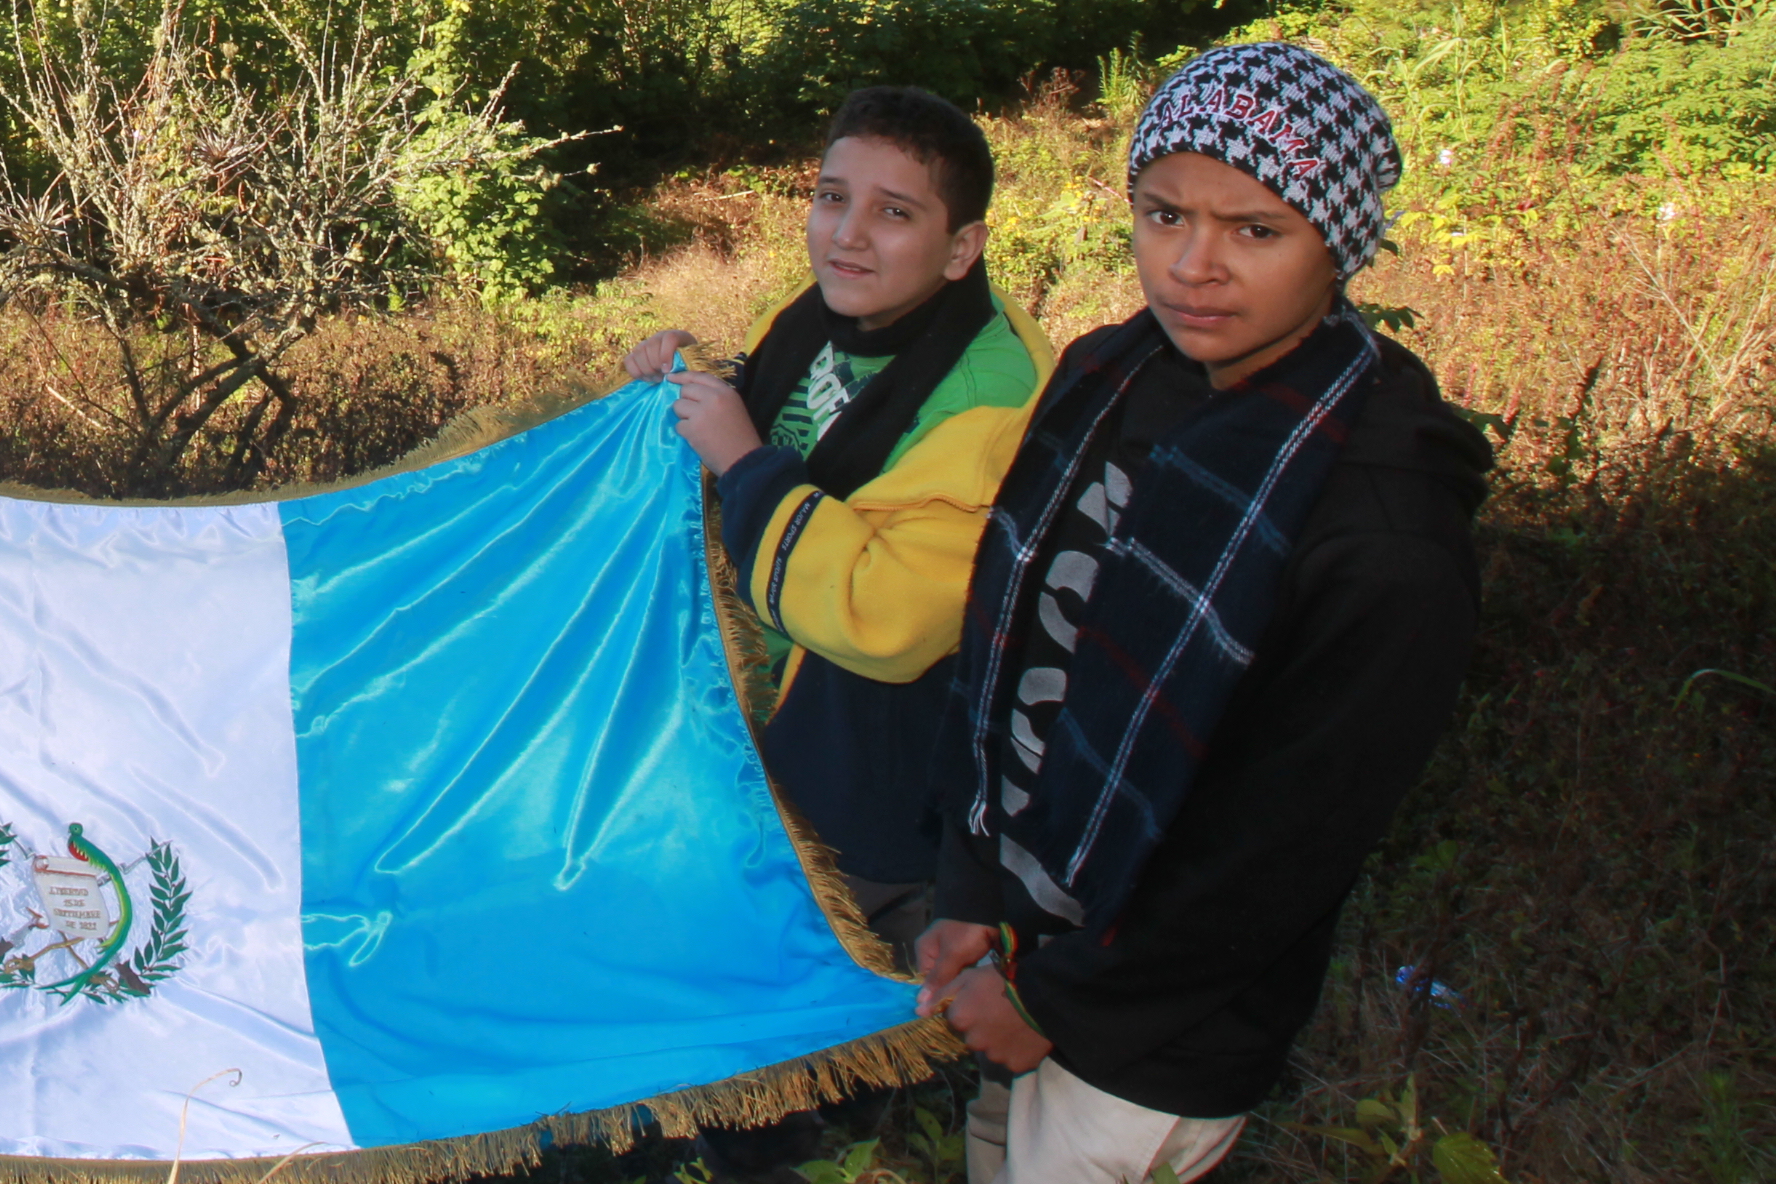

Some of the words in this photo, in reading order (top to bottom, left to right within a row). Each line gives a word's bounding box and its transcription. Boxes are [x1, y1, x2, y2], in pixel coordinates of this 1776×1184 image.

[1157, 87, 1322, 179] ALABAMA
[793, 501, 811, 526] MAJOR
[781, 523, 797, 551] SPORTS
[49, 886, 89, 896] LIBERTAD
